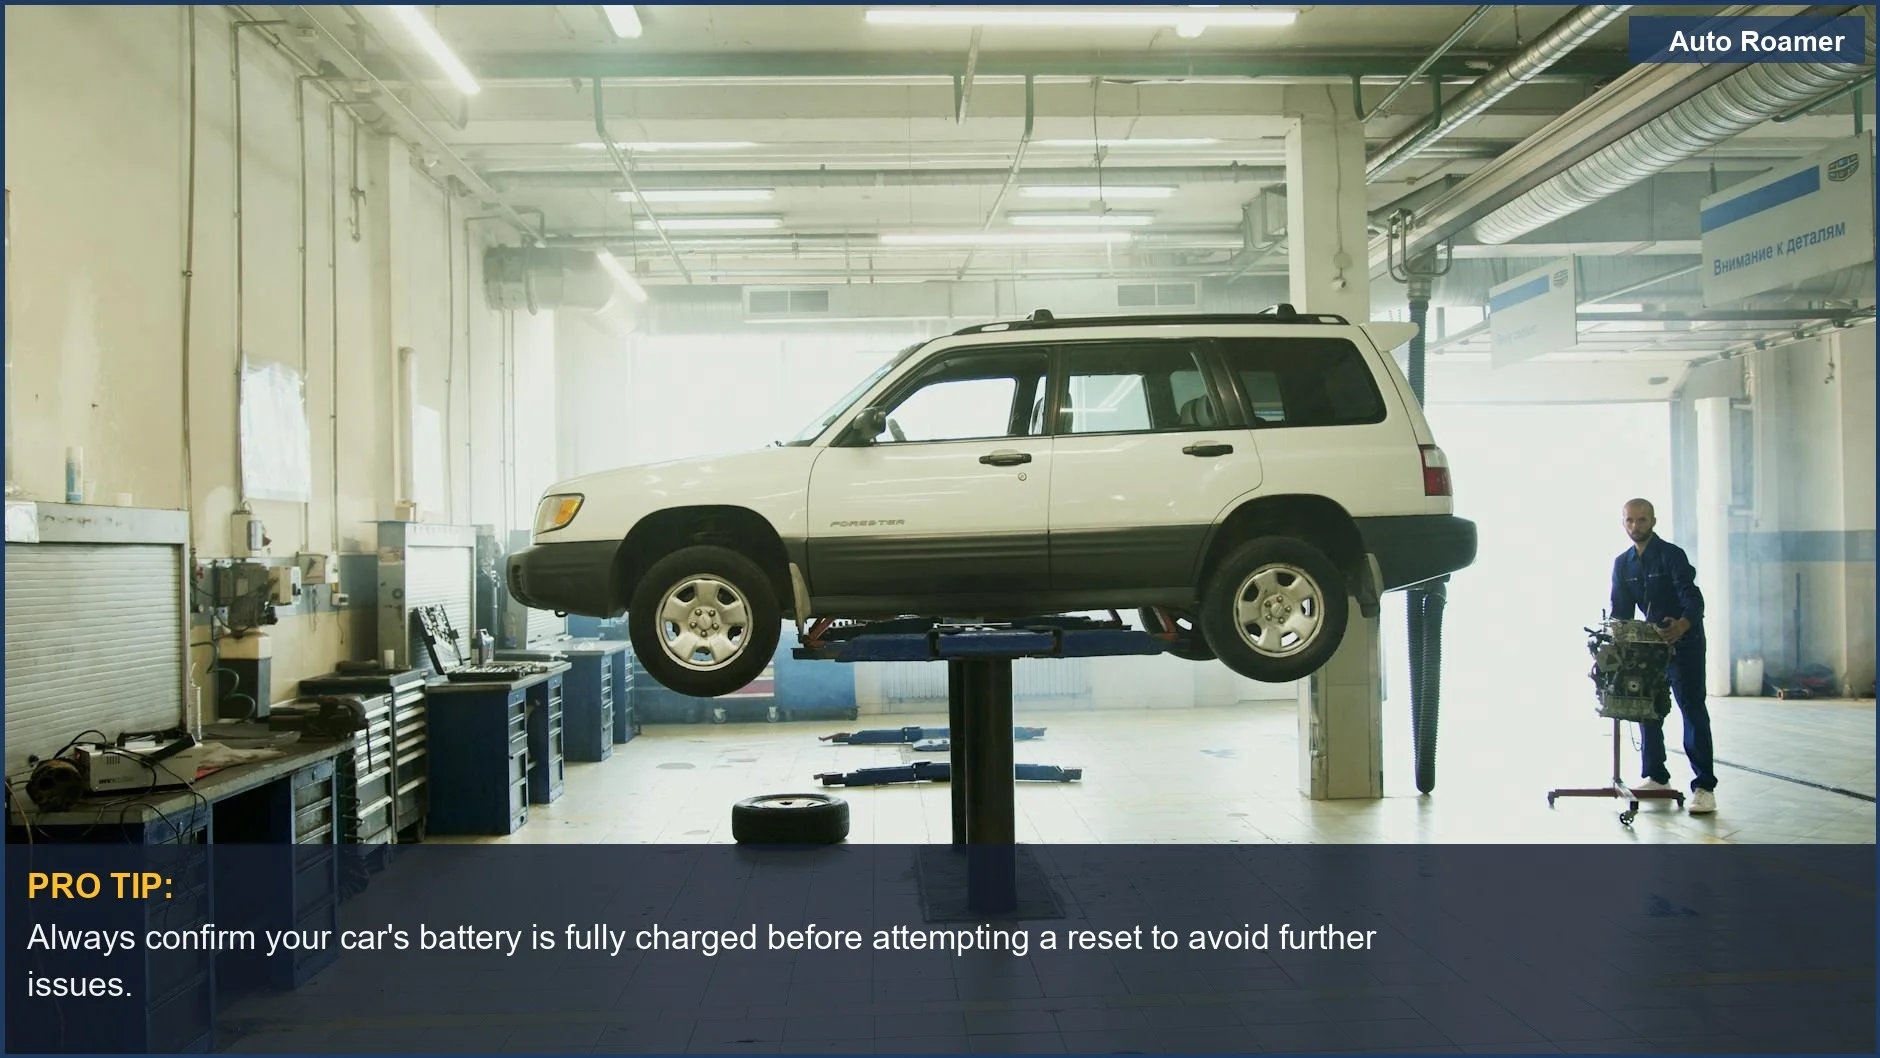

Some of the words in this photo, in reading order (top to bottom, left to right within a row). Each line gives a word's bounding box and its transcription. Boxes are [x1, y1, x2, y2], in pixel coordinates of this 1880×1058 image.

[1713, 246, 1773, 276] Внимание
[1777, 241, 1784, 256] к
[1786, 221, 1846, 256] деталям
[830, 519, 906, 528] FORESTER
